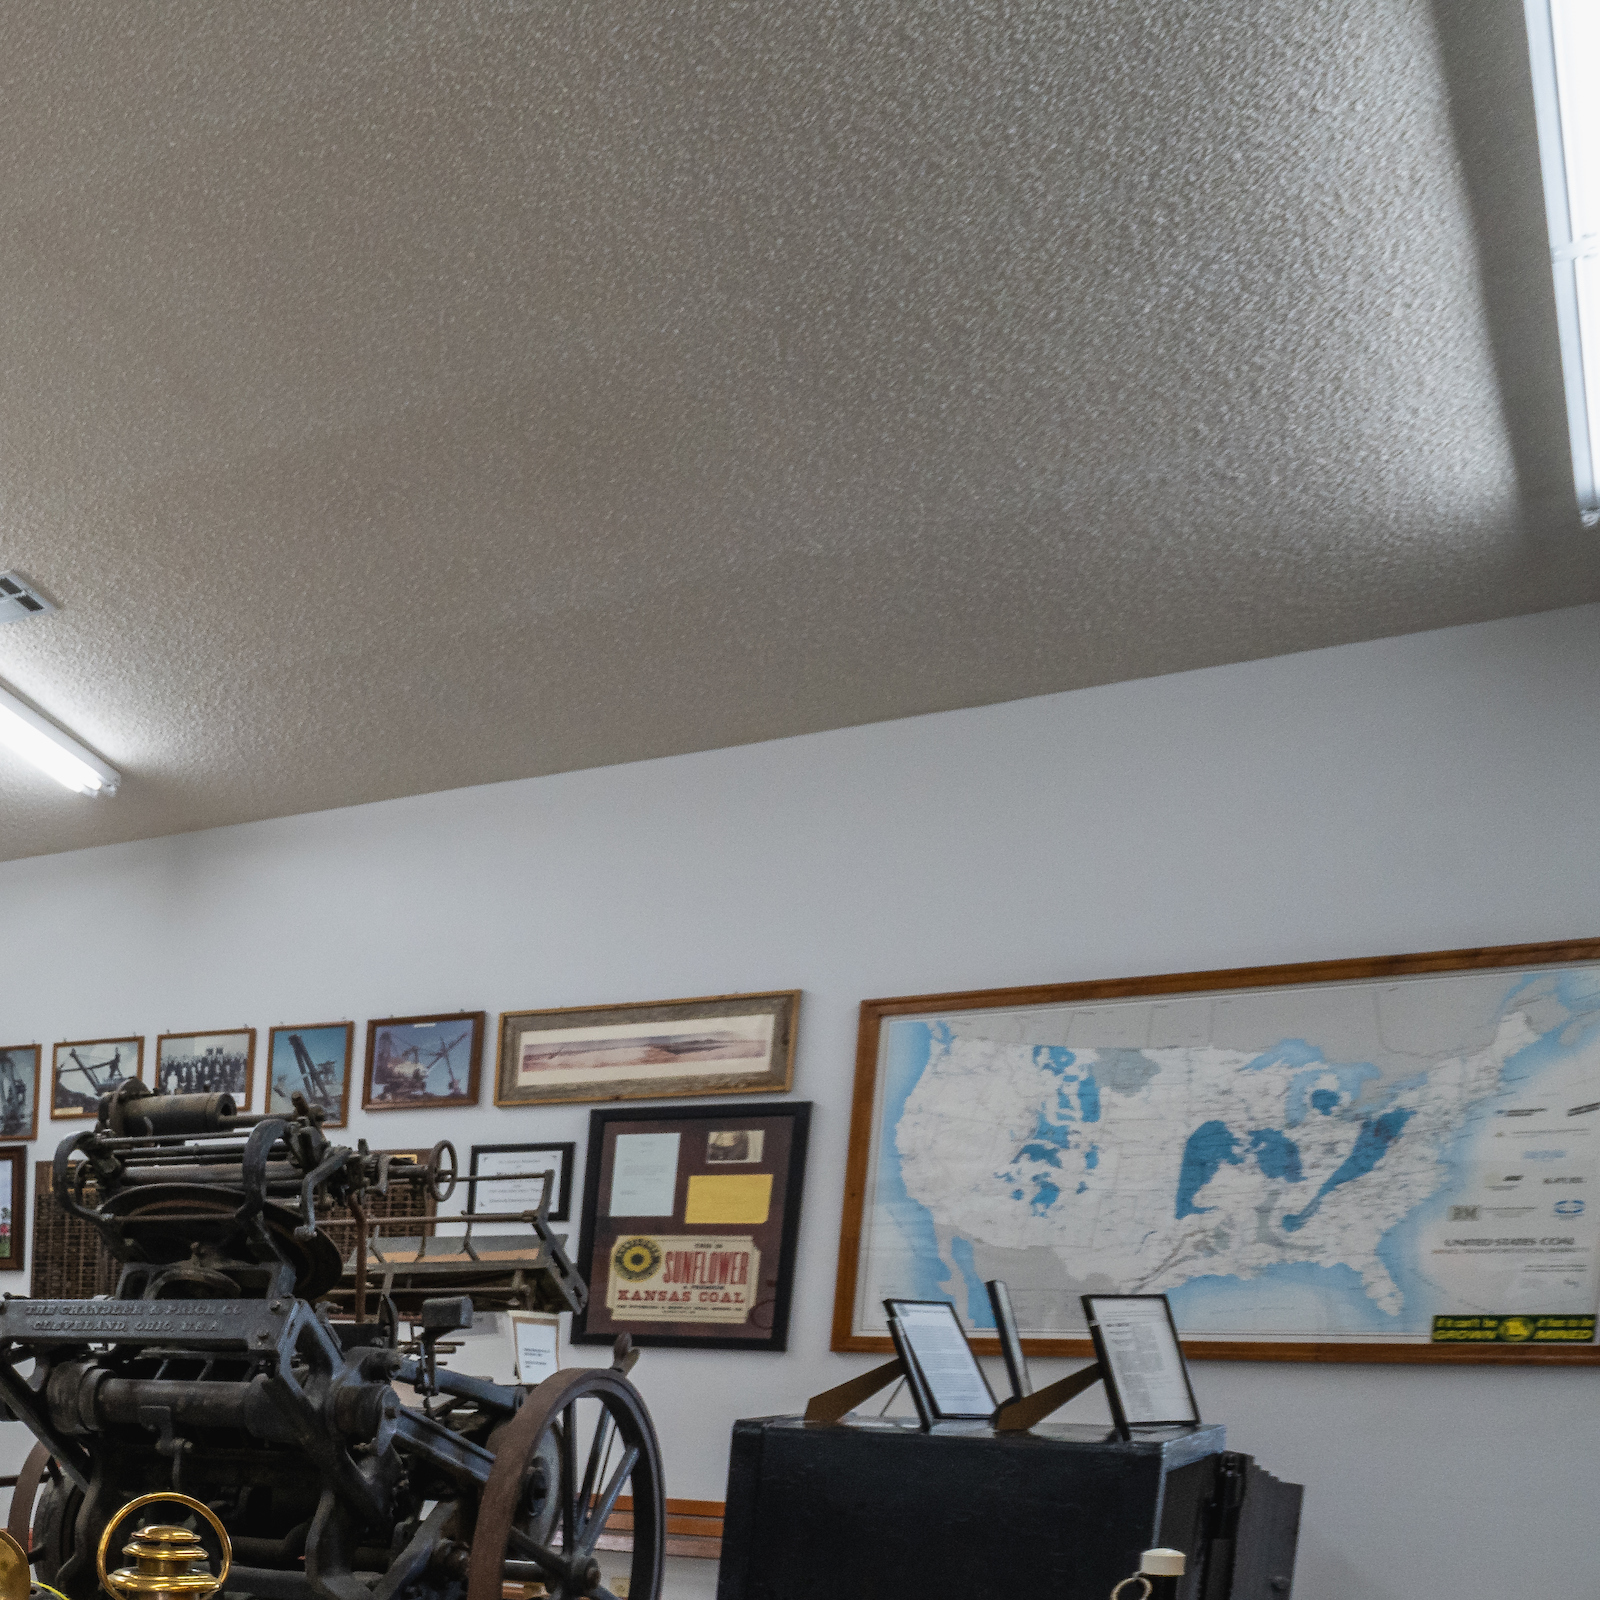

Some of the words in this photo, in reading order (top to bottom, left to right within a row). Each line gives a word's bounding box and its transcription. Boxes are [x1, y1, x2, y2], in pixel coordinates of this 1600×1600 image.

[663, 1251, 750, 1284] SUNFLOWER
[618, 1289, 692, 1302] KANSAS
[697, 1291, 746, 1304] COAL
[25, 1305, 57, 1316] THE
[60, 1305, 144, 1316] CHANDLER
